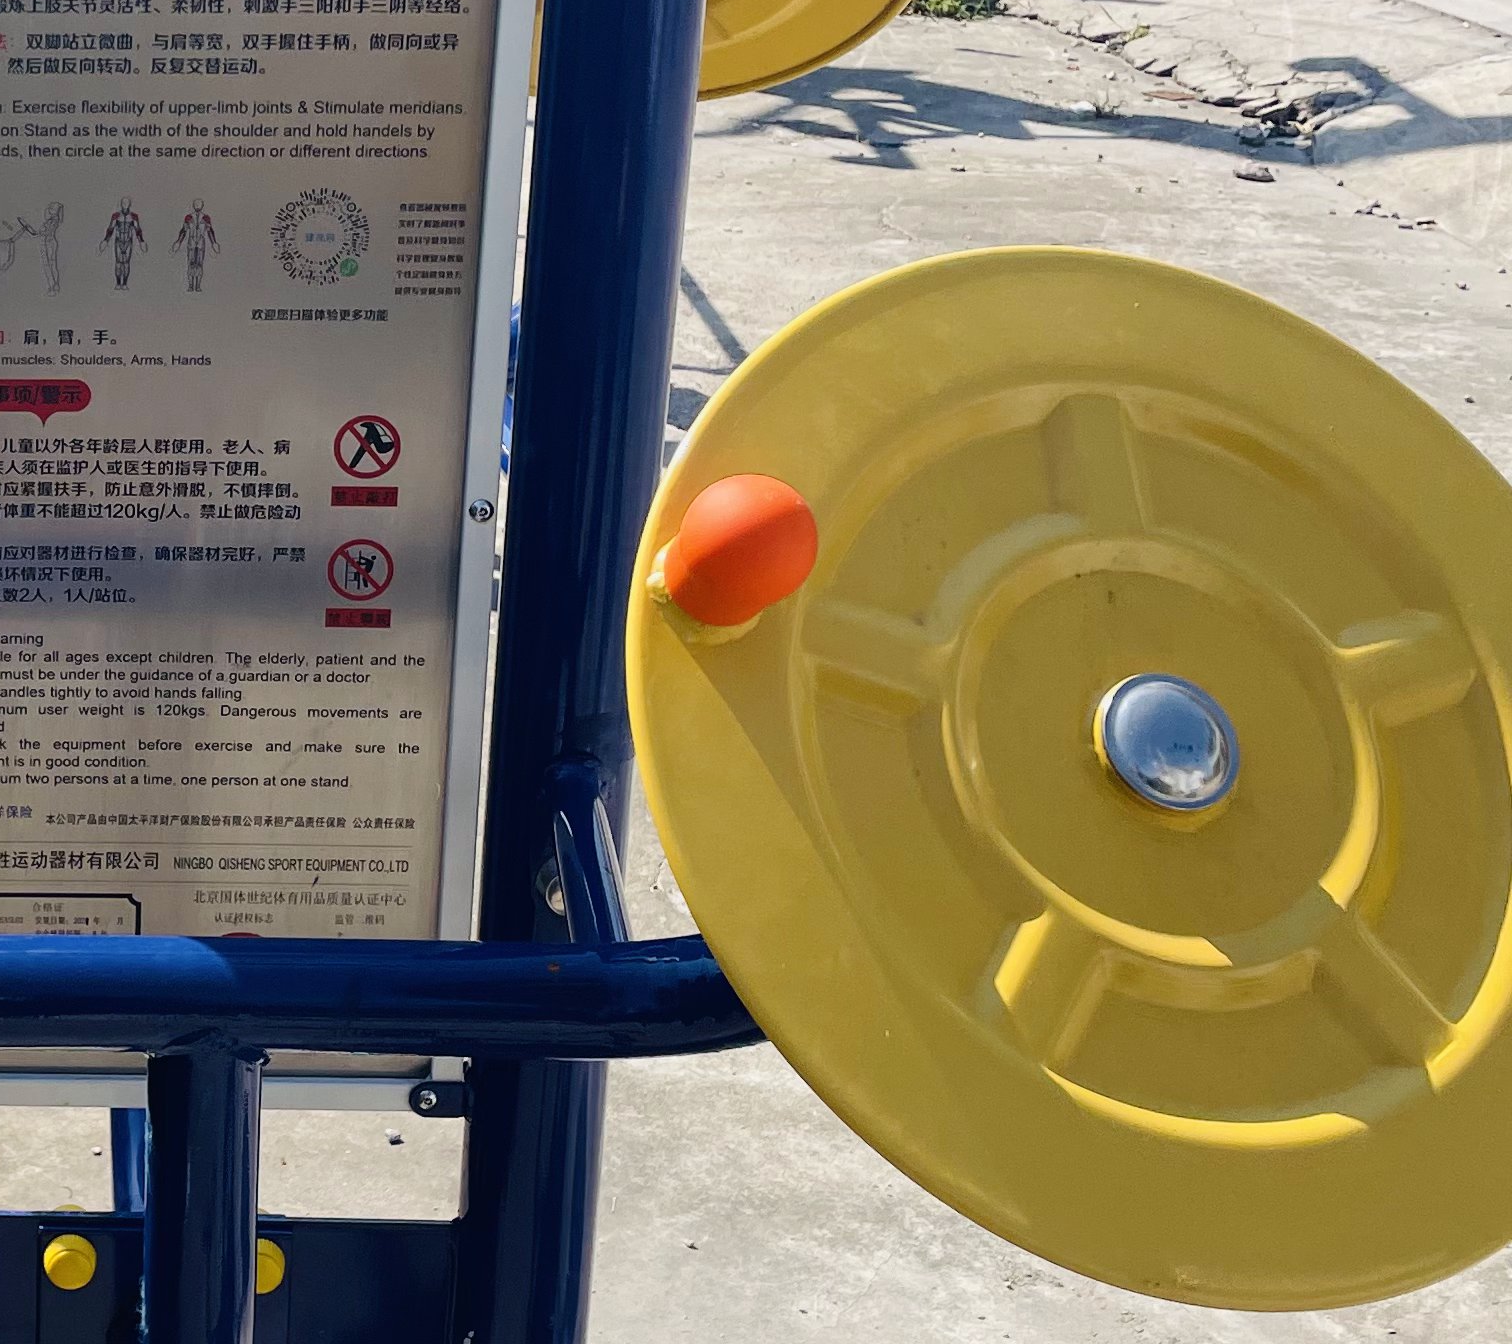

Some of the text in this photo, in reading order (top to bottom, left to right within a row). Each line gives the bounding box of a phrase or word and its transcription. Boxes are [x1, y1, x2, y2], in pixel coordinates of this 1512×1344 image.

[13, 100, 76, 114] Exercise
[82, 100, 145, 117] flexibility
[150, 100, 164, 114] of
[169, 100, 248, 118] upper-limb
[251, 100, 292, 117] joints
[298, 101, 308, 114] &
[313, 100, 384, 115] Stimulate
[25, 123, 67, 137] Stand
[72, 127, 90, 137] as
[95, 123, 118, 137] the
[123, 124, 162, 137] width
[167, 123, 181, 137] of
[186, 123, 208, 137] the
[214, 124, 279, 138] shoulder
[283, 124, 311, 138] and
[316, 124, 347, 138] hold
[353, 124, 412, 138] handels
[417, 124, 435, 141] by
[29, 144, 60, 159] then
[66, 144, 104, 157] circle
[109, 145, 124, 157] at
[128, 144, 150, 157] the
[156, 147, 196, 157] same
[202, 144, 264, 158] direction
[270, 147, 285, 157] or
[290, 144, 350, 158] different
[172, 354, 211, 365] Hands
[19, 651, 36, 662] for
[44, 651, 59, 662] all
[66, 653, 99, 666] ages
[106, 653, 152, 665] except
[225, 652, 252, 665] The
[316, 653, 364, 667] patient
[370, 654, 396, 666] and
[404, 654, 425, 666] the
[0, 669, 33, 681] must
[38, 669, 55, 681] be
[60, 669, 100, 681] under
[104, 669, 125, 681] the
[130, 669, 193, 683] guidance
[198, 669, 212, 681] of
[216, 672, 224, 681] a
[229, 670, 290, 684] guardian
[295, 673, 309, 682] or
[313, 673, 321, 683] a
[51, 687, 91, 701] tightly
[96, 687, 108, 698] to
[113, 687, 151, 701] avoid
[155, 687, 197, 702] hands
[38, 706, 69, 715] user
[78, 704, 124, 718] weight
[134, 705, 145, 715] is
[220, 705, 296, 719] Dangerous
[308, 708, 388, 718] movements
[400, 710, 422, 719] are
[19, 739, 40, 751] the
[53, 739, 125, 753] equipment
[139, 739, 182, 750] before
[195, 740, 252, 751] exercise
[266, 741, 291, 753] and
[304, 741, 342, 753] make
[355, 744, 385, 753] sure
[399, 743, 419, 754] the
[14, 756, 25, 767] is
[29, 756, 41, 767] in
[46, 756, 79, 770] good
[26, 773, 49, 784] two
[54, 776, 109, 787] persons
[113, 774, 126, 784] at
[131, 776, 138, 784] a
[181, 777, 207, 785] one
[212, 777, 258, 788] person
[263, 776, 276, 786] at
[281, 778, 306, 787] one
[174, 856, 213, 869] NINGBO
[219, 858, 265, 870] QISHENG
[268, 858, 304, 871] SPORT
[306, 858, 366, 873] EQUIPMENT
